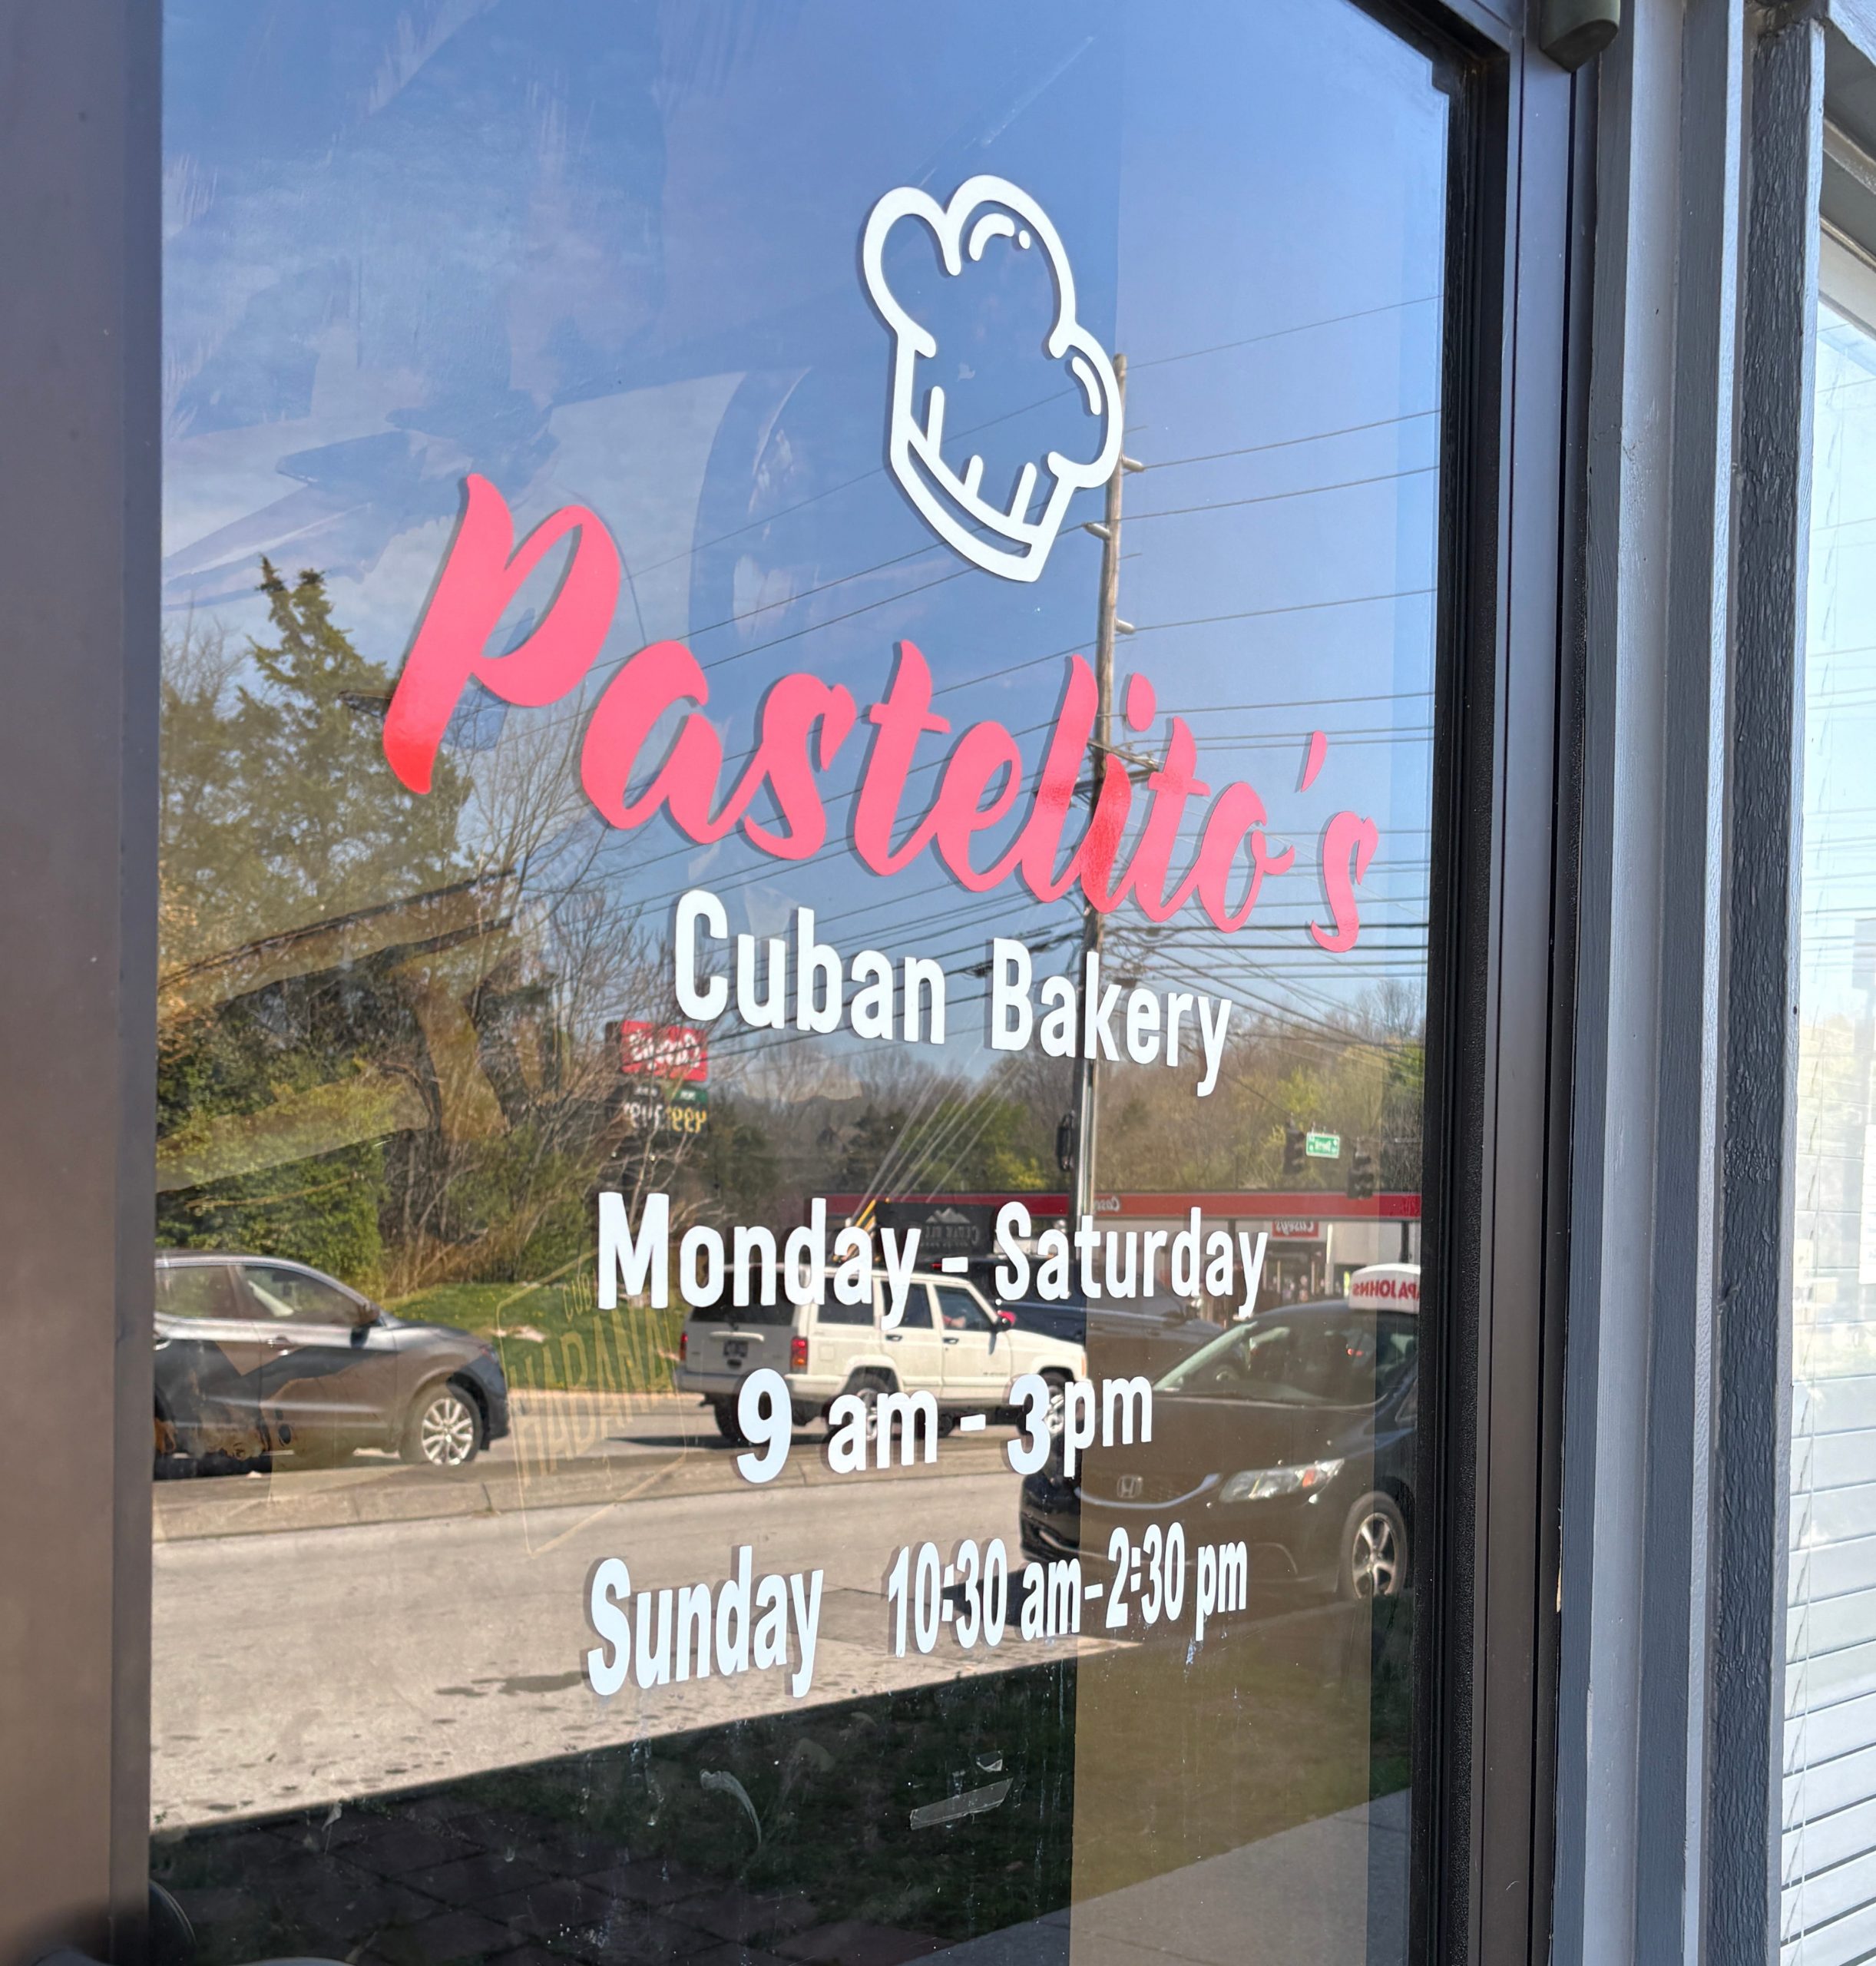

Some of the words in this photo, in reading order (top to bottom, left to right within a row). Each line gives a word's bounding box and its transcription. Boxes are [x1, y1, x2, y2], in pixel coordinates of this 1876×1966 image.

[384, 473, 1379, 953] Pastelito's
[675, 889, 946, 1045] Cuban
[992, 937, 1232, 1097] Bakery
[598, 1191, 921, 1331] Monday
[941, 1256, 969, 1273] -
[995, 1200, 1269, 1319] Saturday
[737, 1368, 792, 1484] 9
[828, 1390, 938, 1474] am
[960, 1414, 986, 1431] -
[587, 1545, 824, 1698] Sunday
[888, 1537, 1007, 1658] 10:30
[1195, 1541, 1248, 1641] pm
